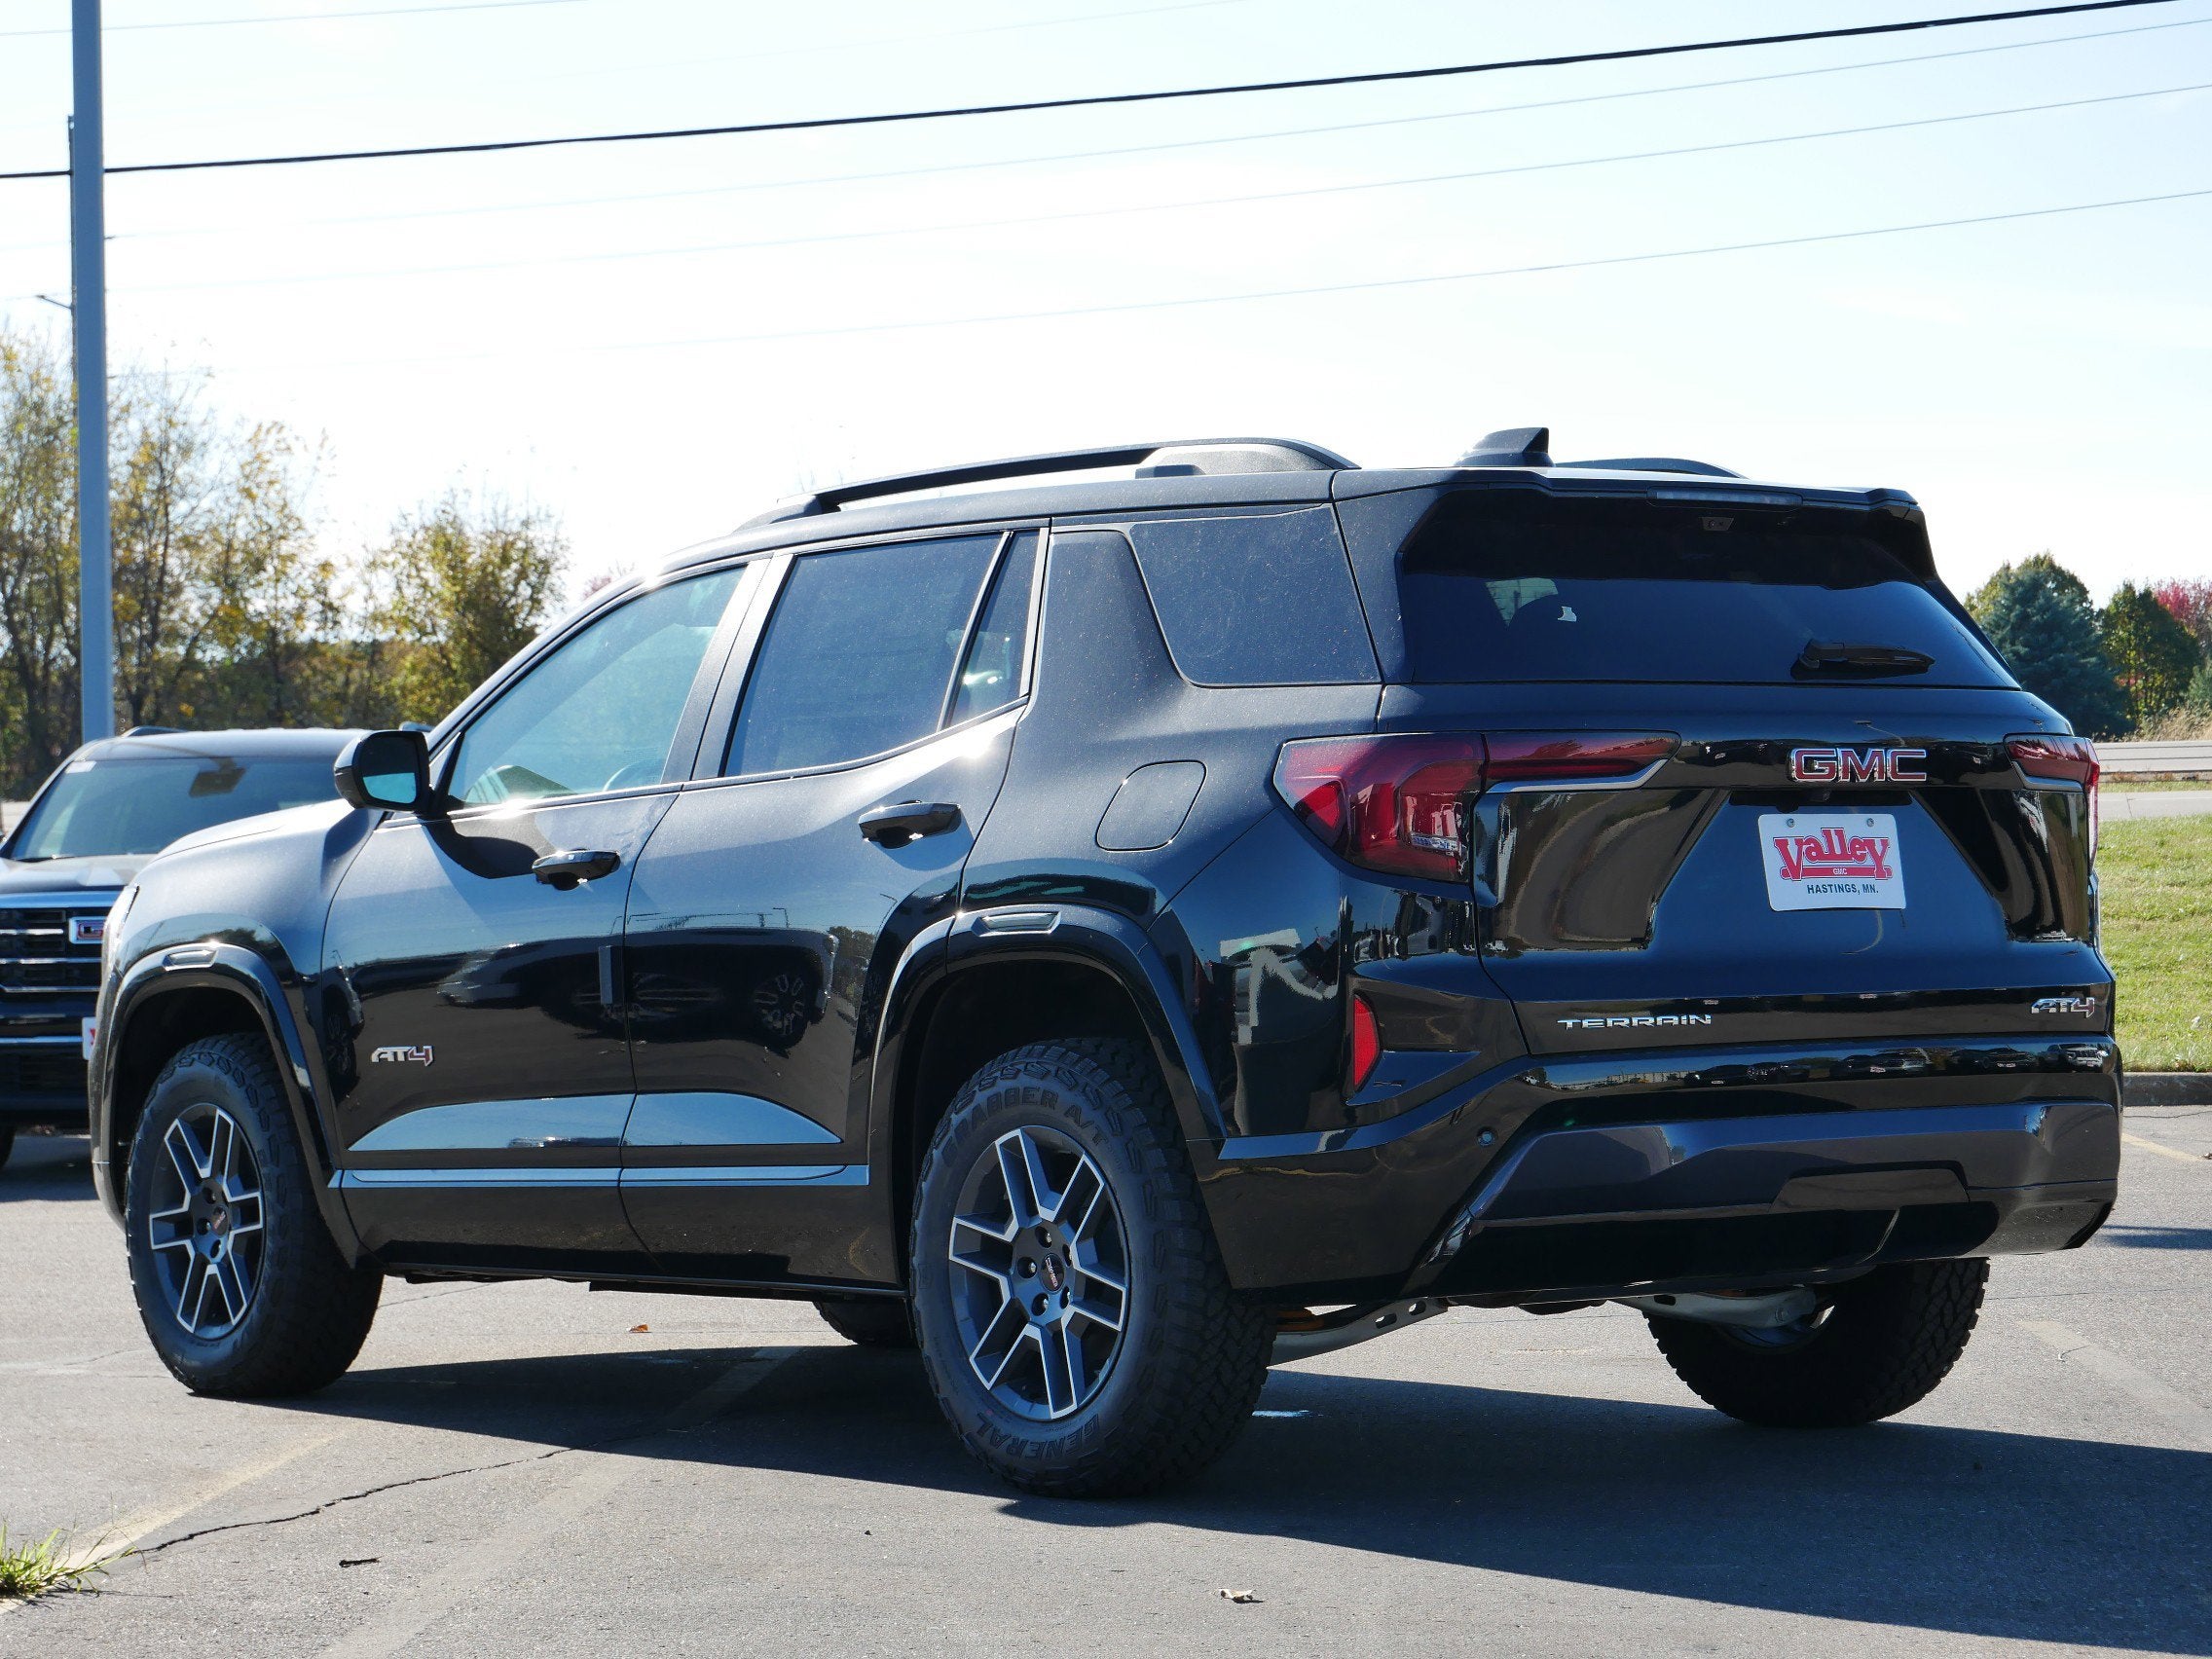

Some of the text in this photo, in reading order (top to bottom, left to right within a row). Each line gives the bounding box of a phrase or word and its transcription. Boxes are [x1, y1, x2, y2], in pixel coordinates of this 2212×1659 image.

[1788, 748, 1927, 782] GMC
[1773, 828, 1891, 881] Valley
[1807, 883, 1879, 895] HASTINGS, MN.
[2031, 997, 2095, 1018] AT4
[1558, 1014, 1712, 1030] TERRAIN
[371, 1045, 433, 1067] AT4
